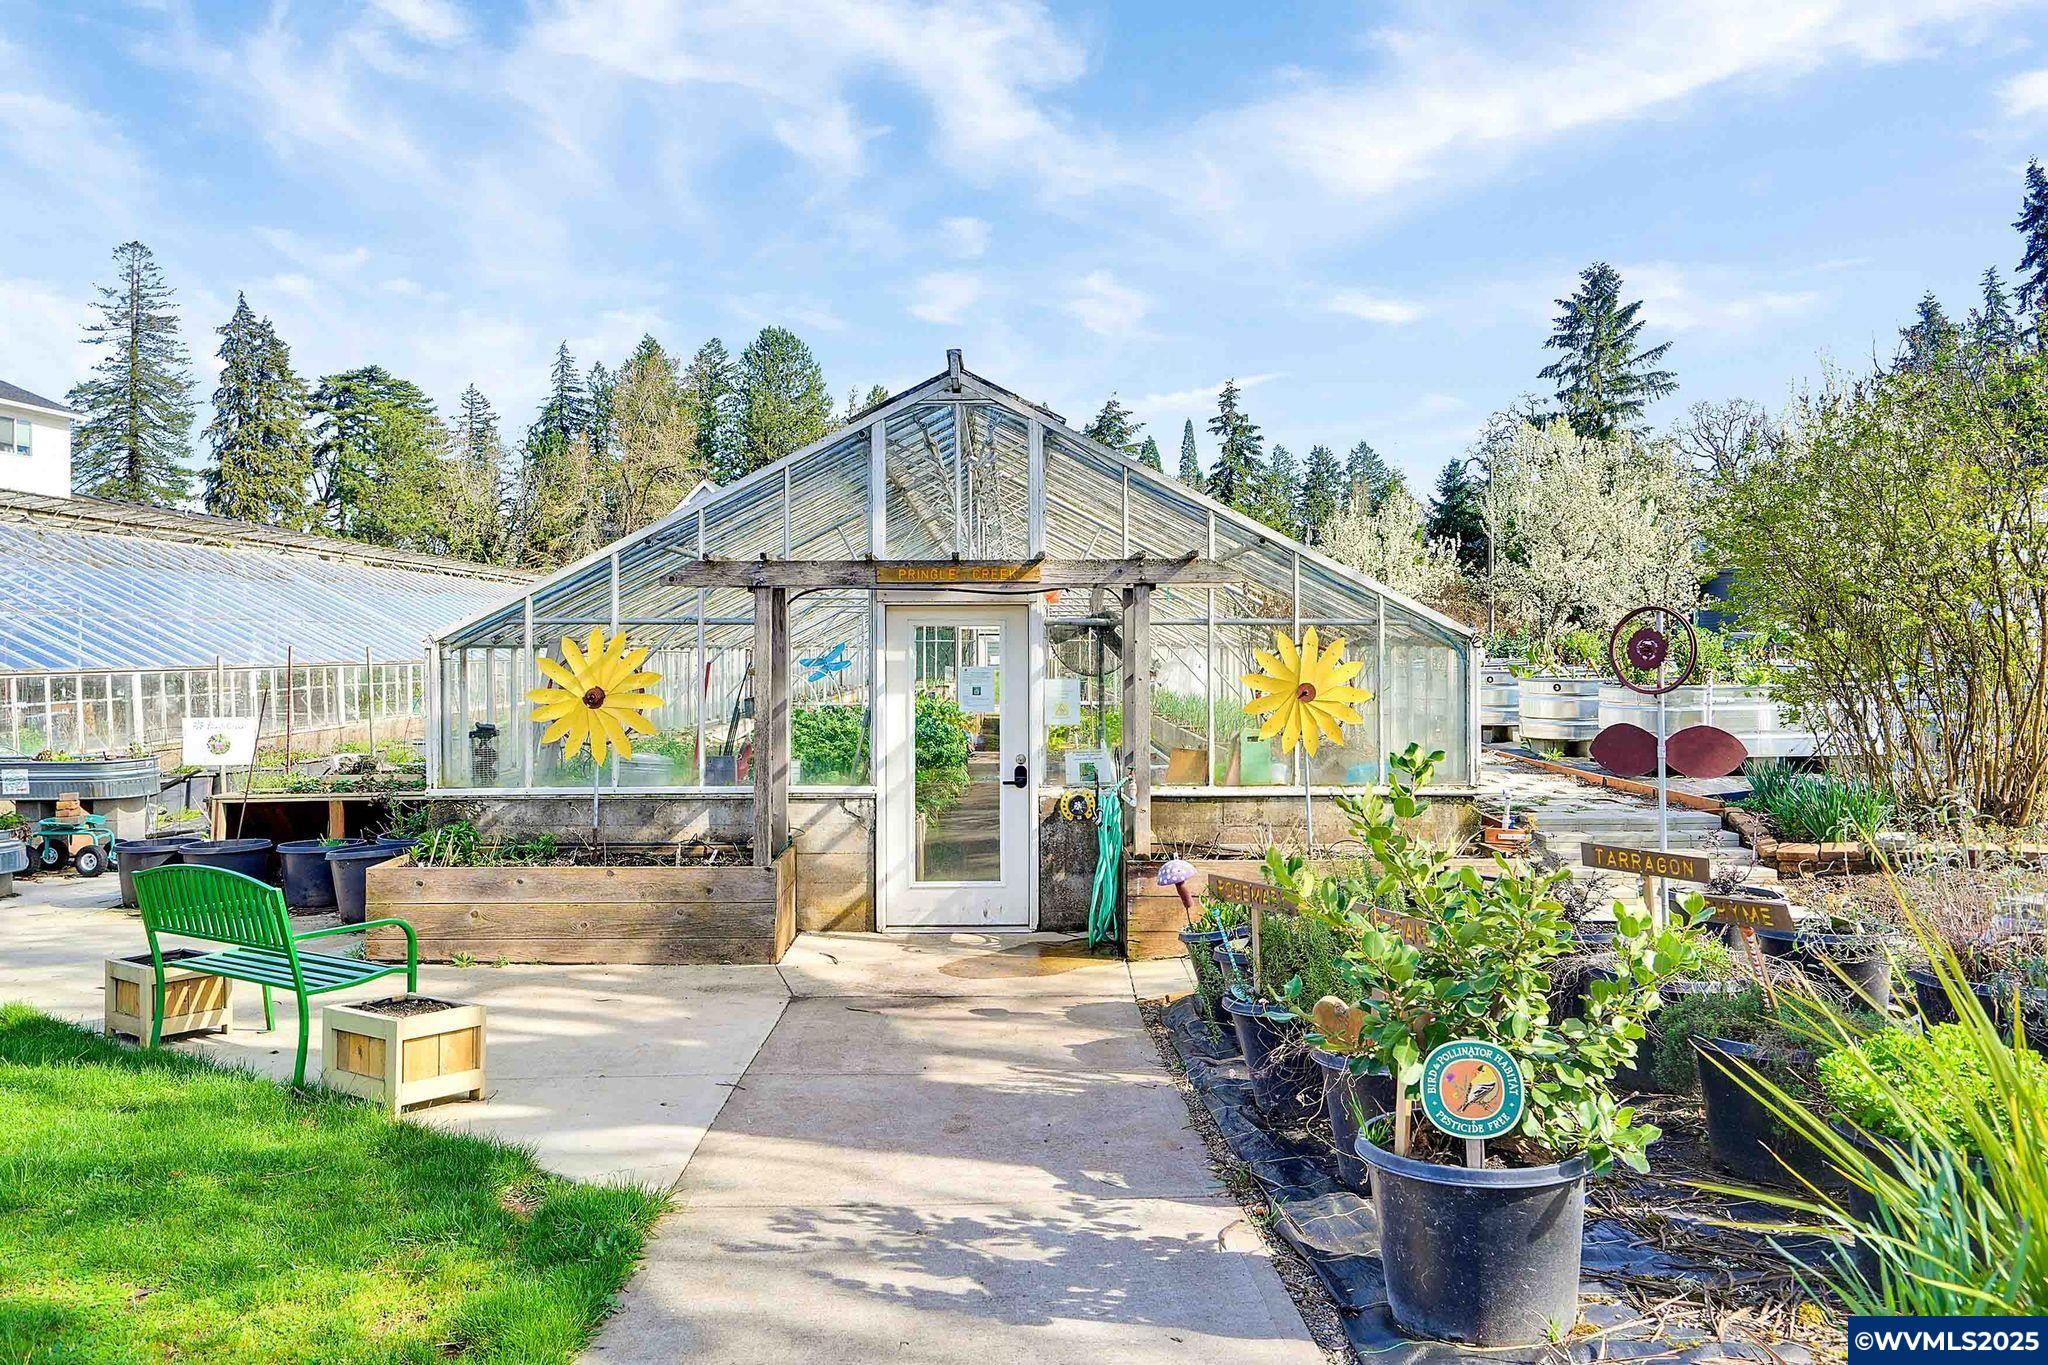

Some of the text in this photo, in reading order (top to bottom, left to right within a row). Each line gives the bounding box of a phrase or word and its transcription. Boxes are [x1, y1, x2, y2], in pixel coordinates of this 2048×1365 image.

[898, 567, 1018, 580] PRINGLE CREEK
[1594, 848, 1695, 878] TARRAGON
[1427, 1069, 1438, 1094] BIRD
[1437, 1046, 1493, 1065] POLLINATOR
[1493, 1054, 1520, 1096] HABITAT
[1435, 1110, 1511, 1133] PESTICIDE FREE
